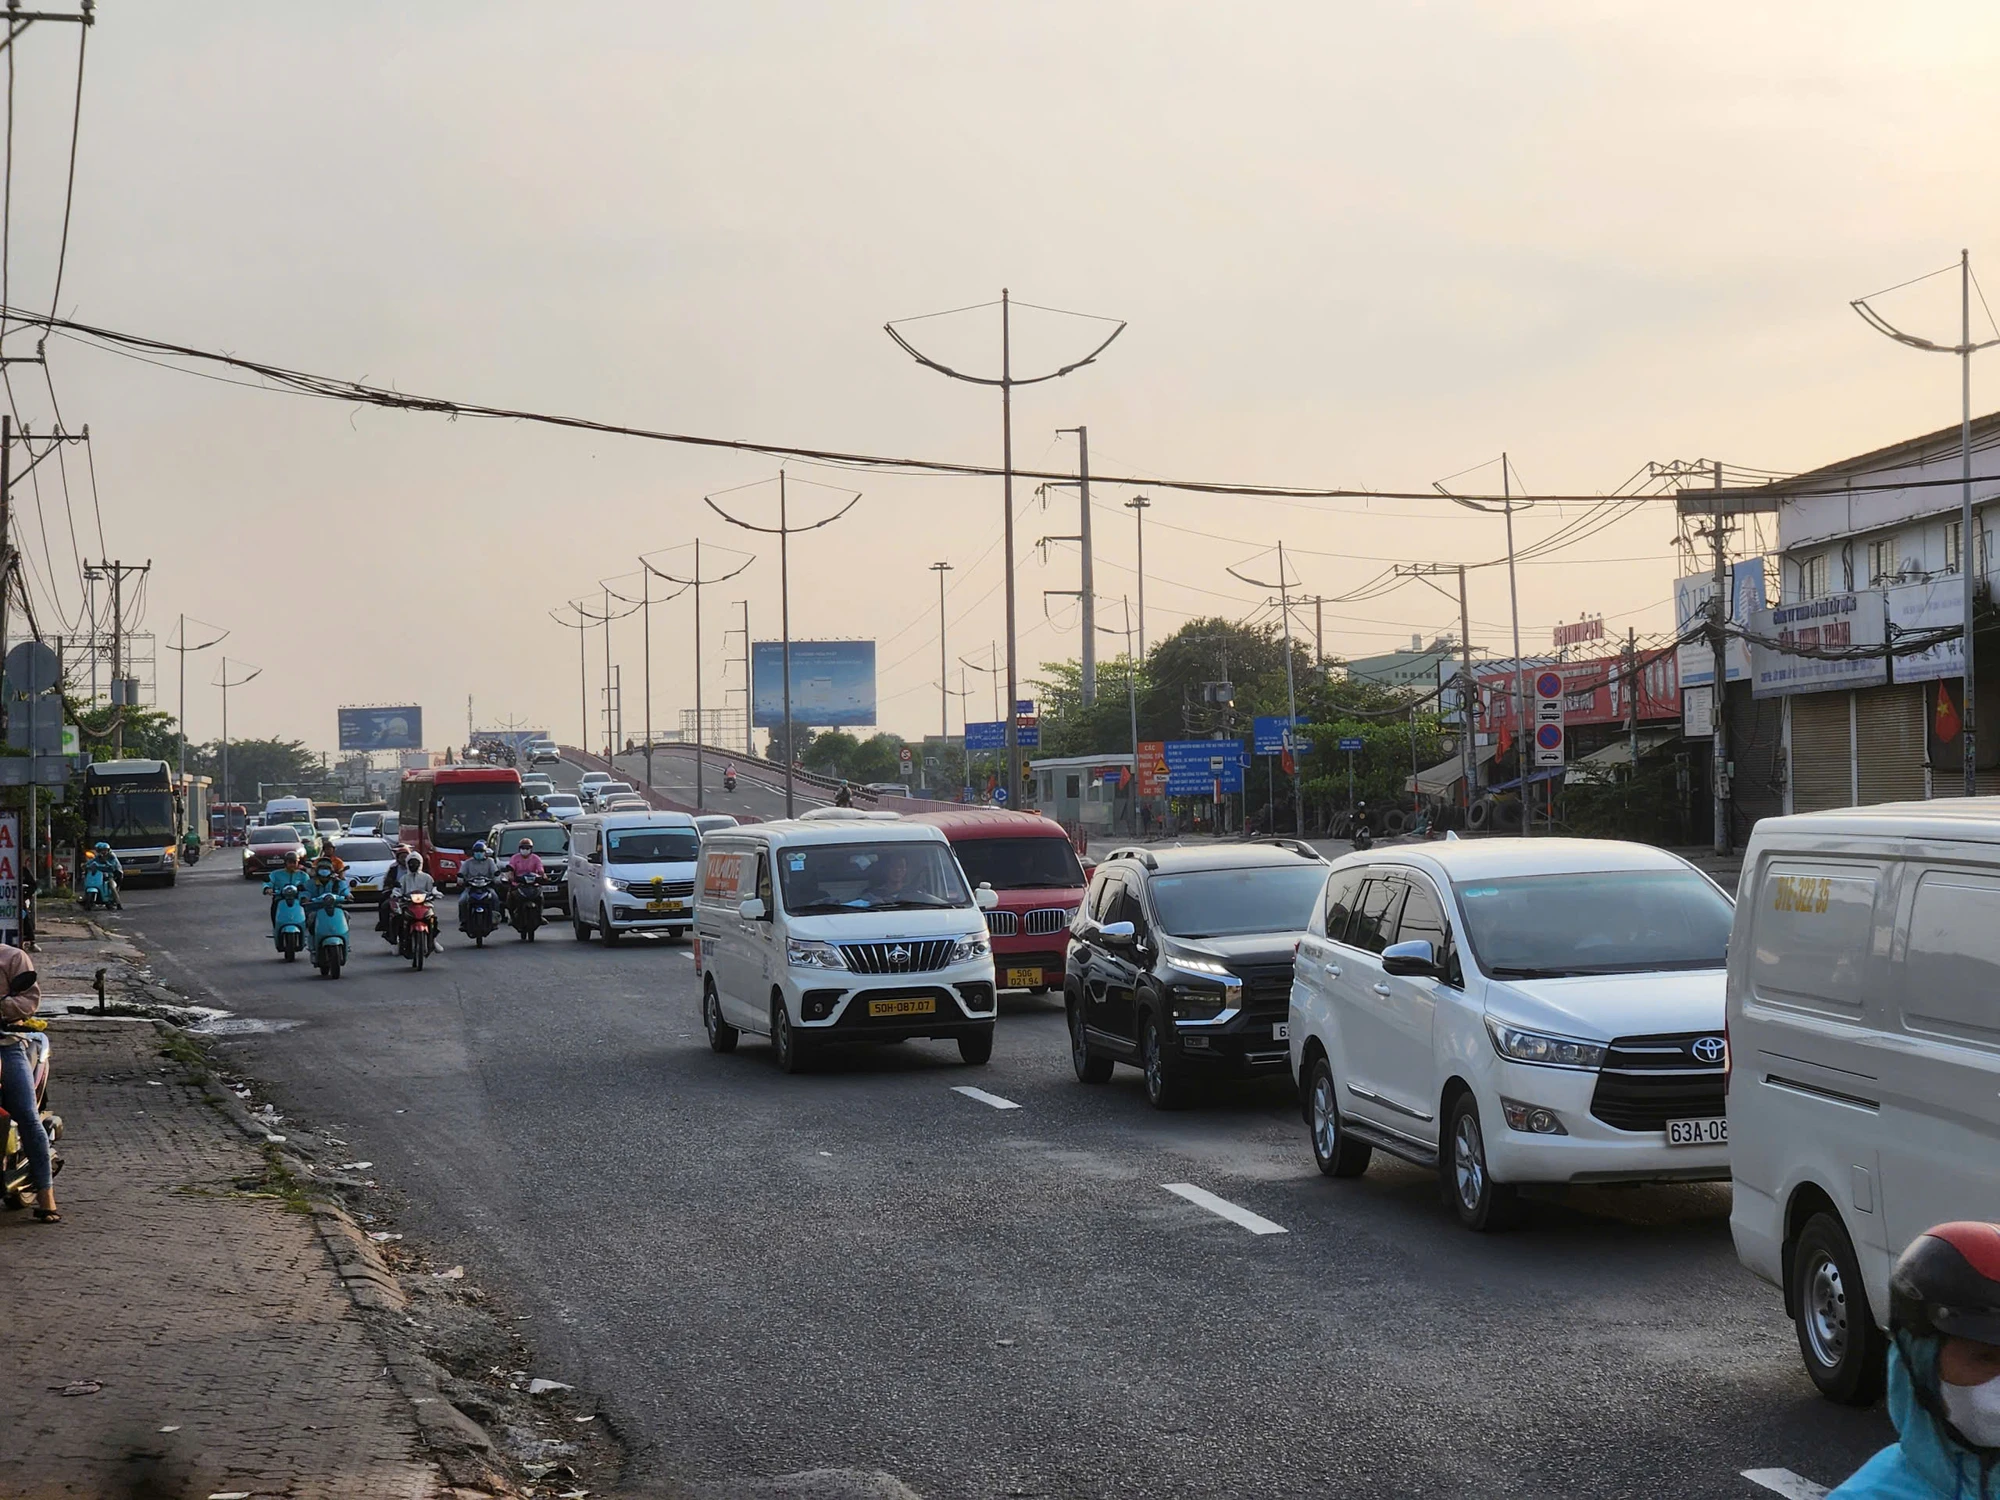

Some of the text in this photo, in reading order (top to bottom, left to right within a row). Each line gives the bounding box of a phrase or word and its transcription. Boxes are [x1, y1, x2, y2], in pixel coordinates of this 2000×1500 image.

[90, 786, 169, 796] VIP Limousine
[1016, 969, 1032, 977] 50G
[1010, 977, 1039, 986] 021.94
[874, 1001, 930, 1013] 50H-087.07
